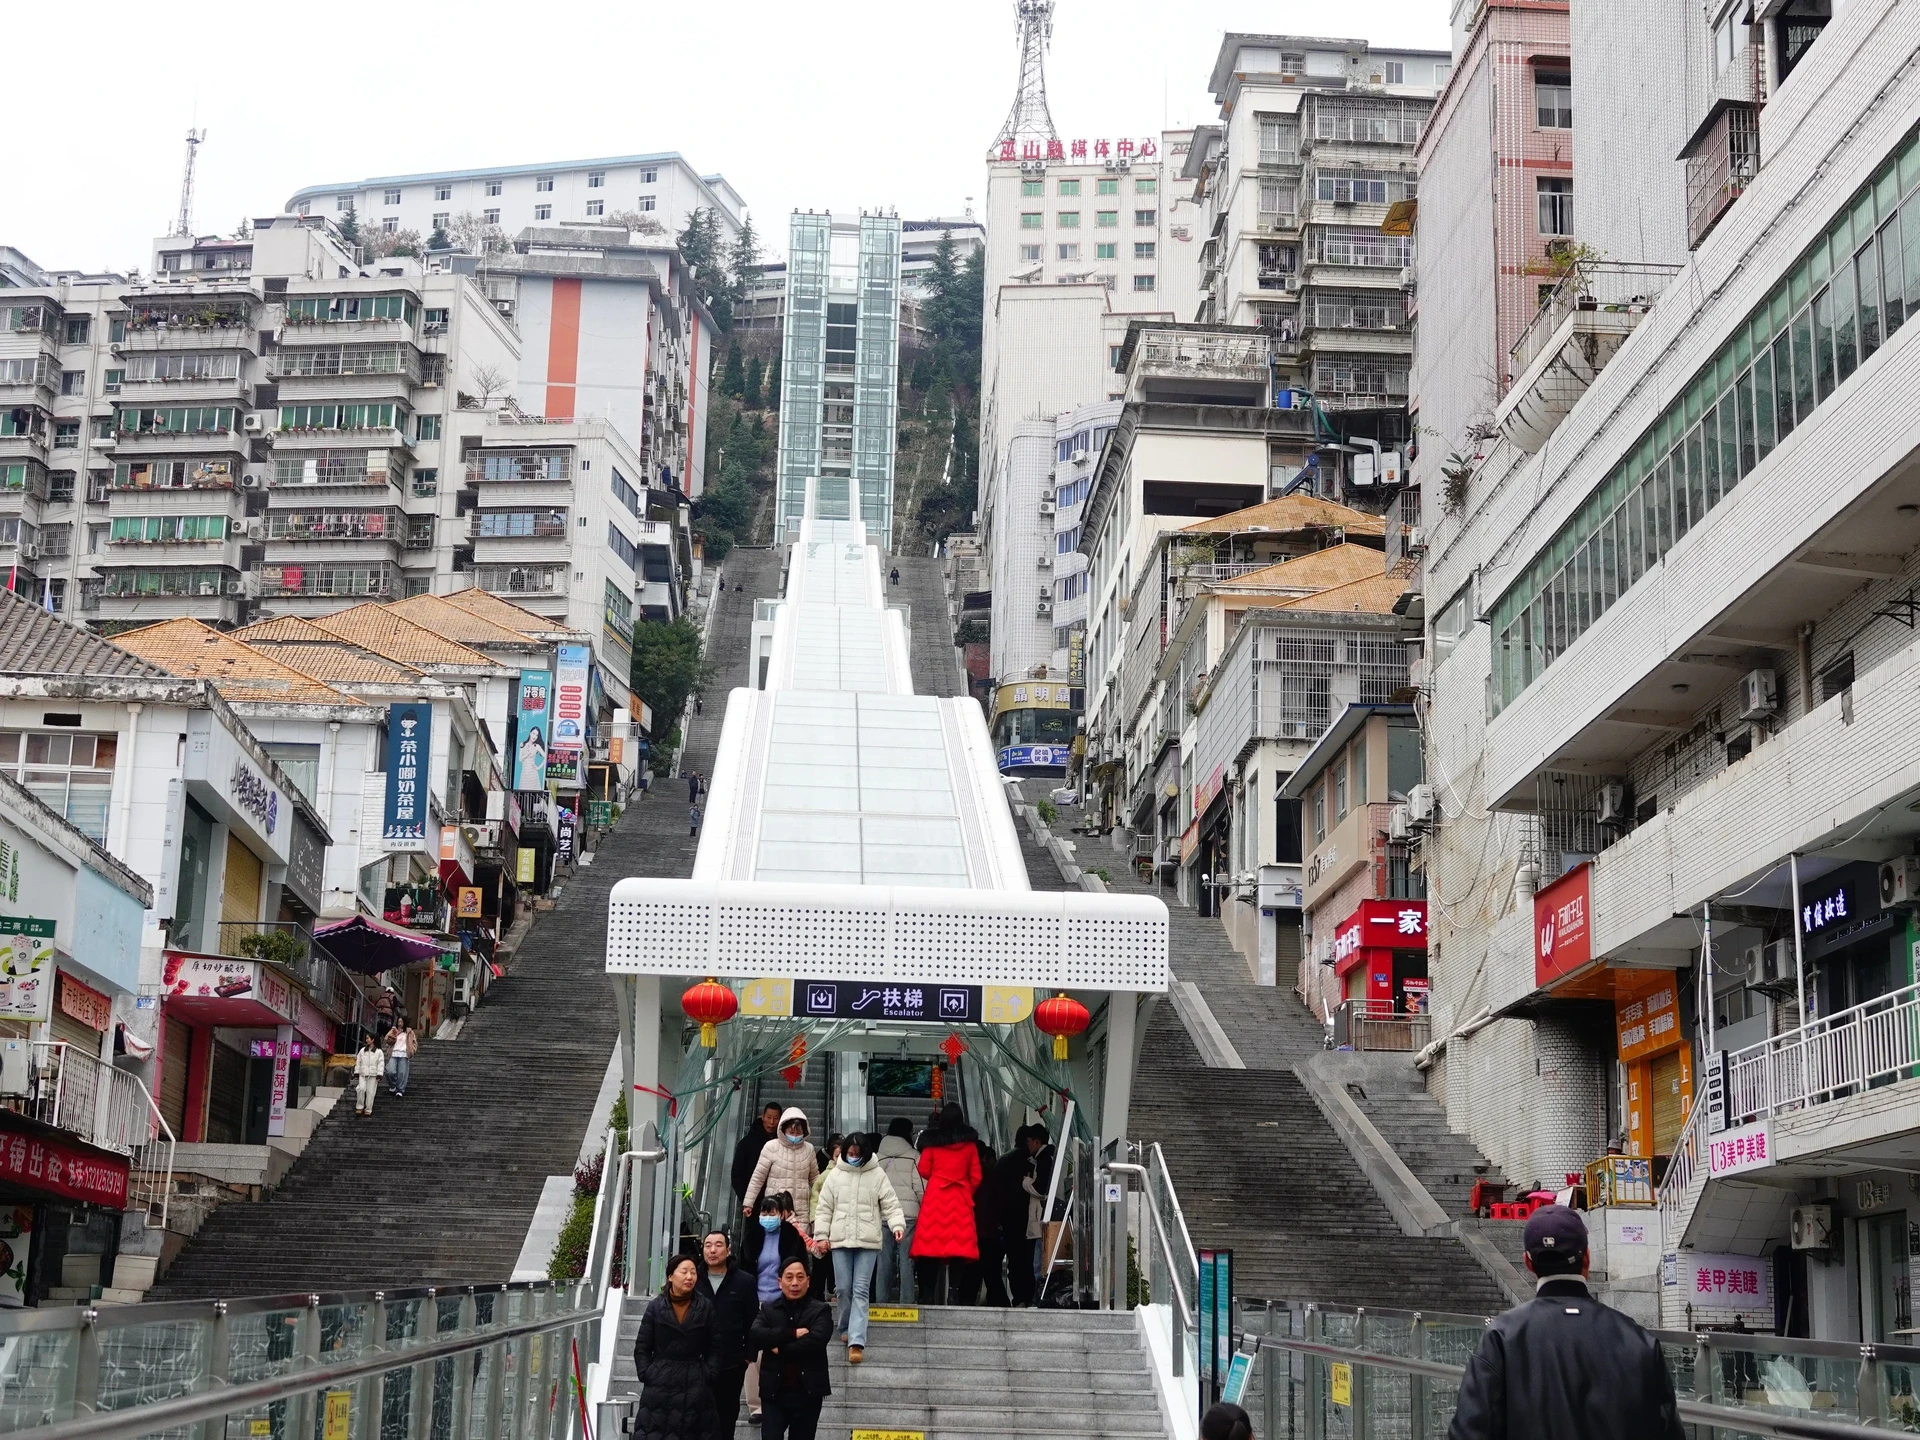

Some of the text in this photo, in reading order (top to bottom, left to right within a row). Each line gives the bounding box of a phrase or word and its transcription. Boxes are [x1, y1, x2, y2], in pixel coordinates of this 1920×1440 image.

[1000, 138, 1157, 161] 巫山融媒体中心
[396, 740, 418, 820] 茶小嘟奶茶屋
[559, 827, 572, 851] 尚艺
[1557, 895, 1583, 929] 万机千红
[191, 960, 246, 974] 厚切炒酸奶
[771, 983, 785, 1012] 出口
[882, 988, 924, 1009] 扶梯
[990, 991, 1004, 1019] 入口
[883, 1008, 924, 1018] Escalator
[272, 1041, 288, 1106] 冰糖葫芦
[1696, 1267, 1759, 1295] 美甲美睫
